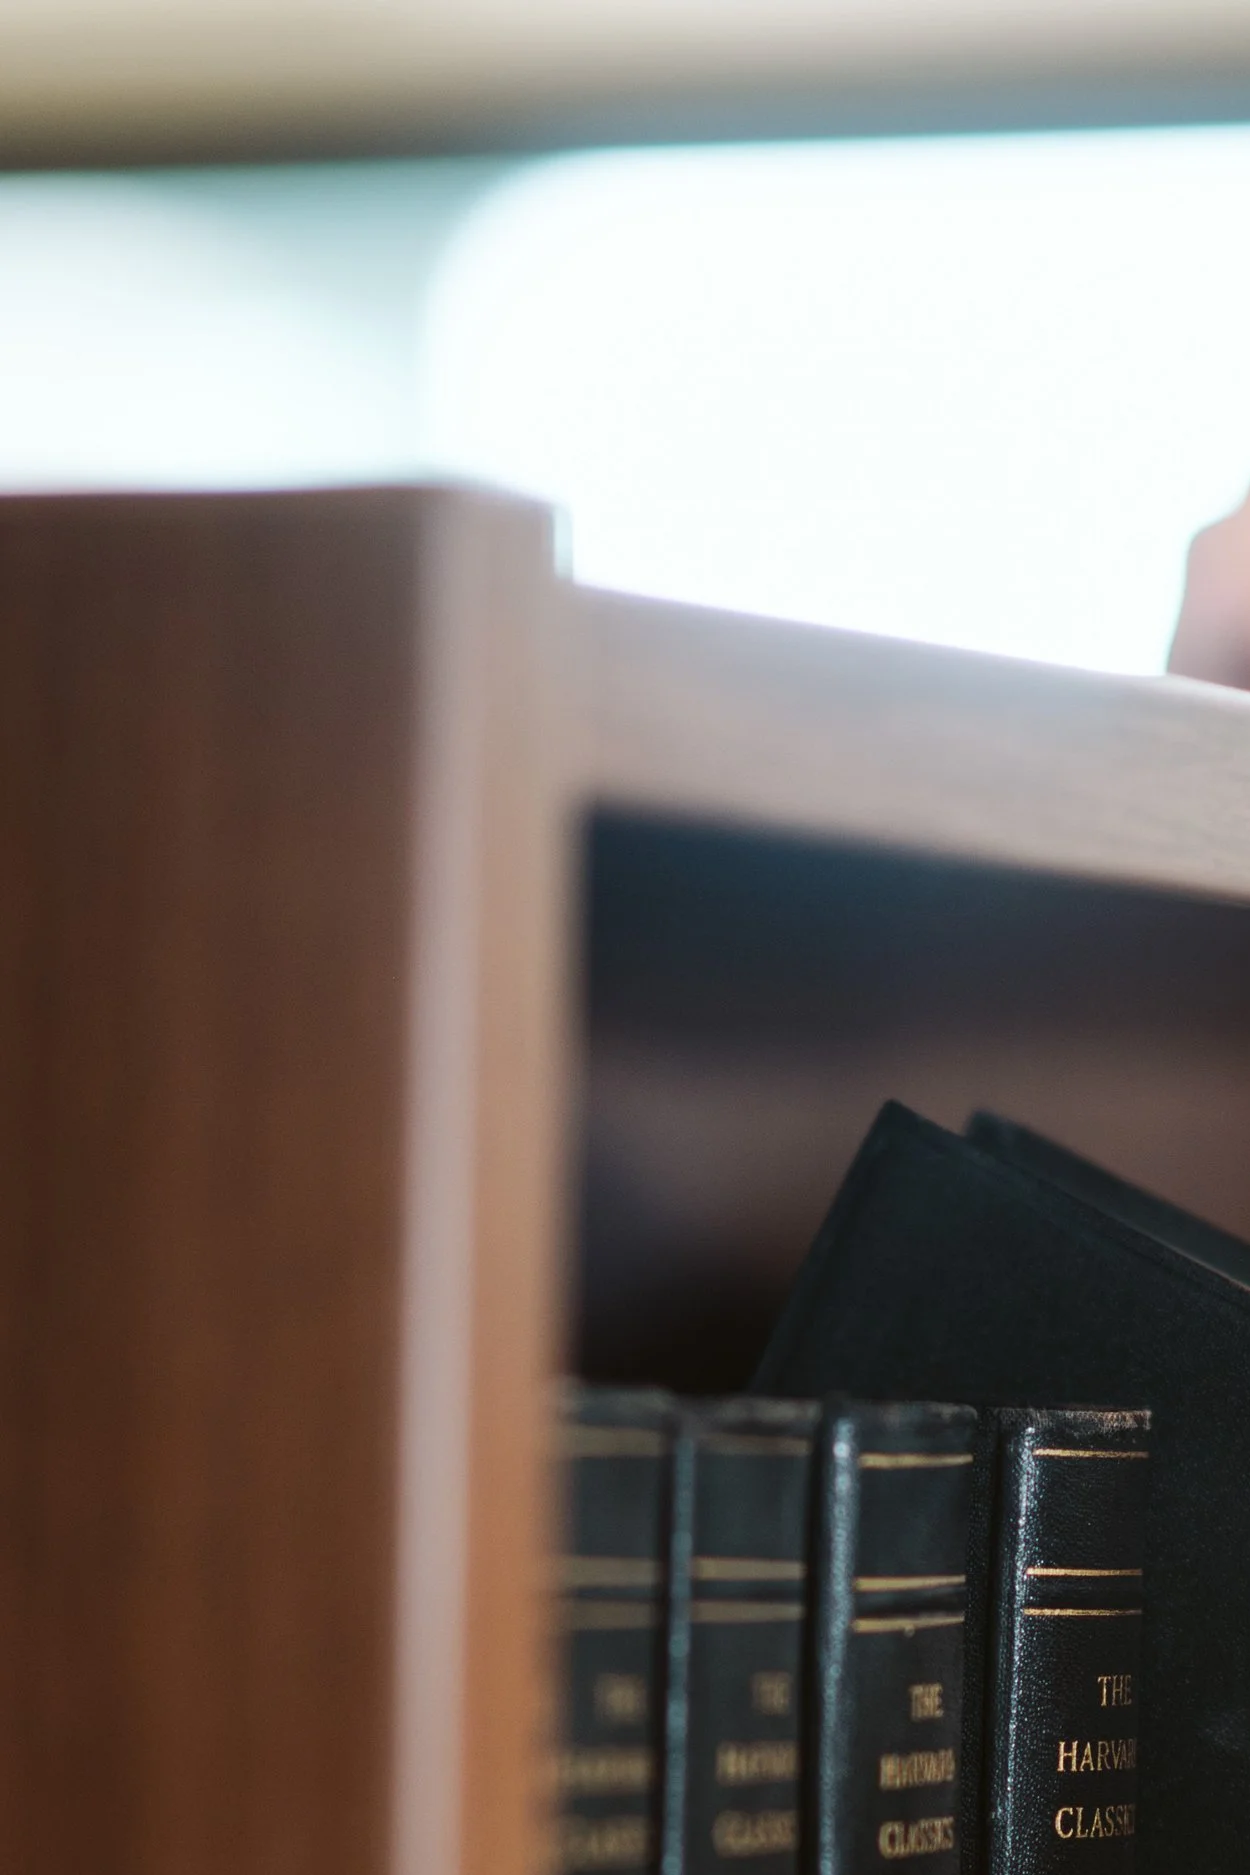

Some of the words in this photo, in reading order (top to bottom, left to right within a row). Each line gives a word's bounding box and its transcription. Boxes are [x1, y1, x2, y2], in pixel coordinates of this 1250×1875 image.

[1097, 1674, 1133, 1707] THE
[1056, 1737, 1138, 1773] HARVAR
[1055, 1803, 1138, 1839] CLASSIC
